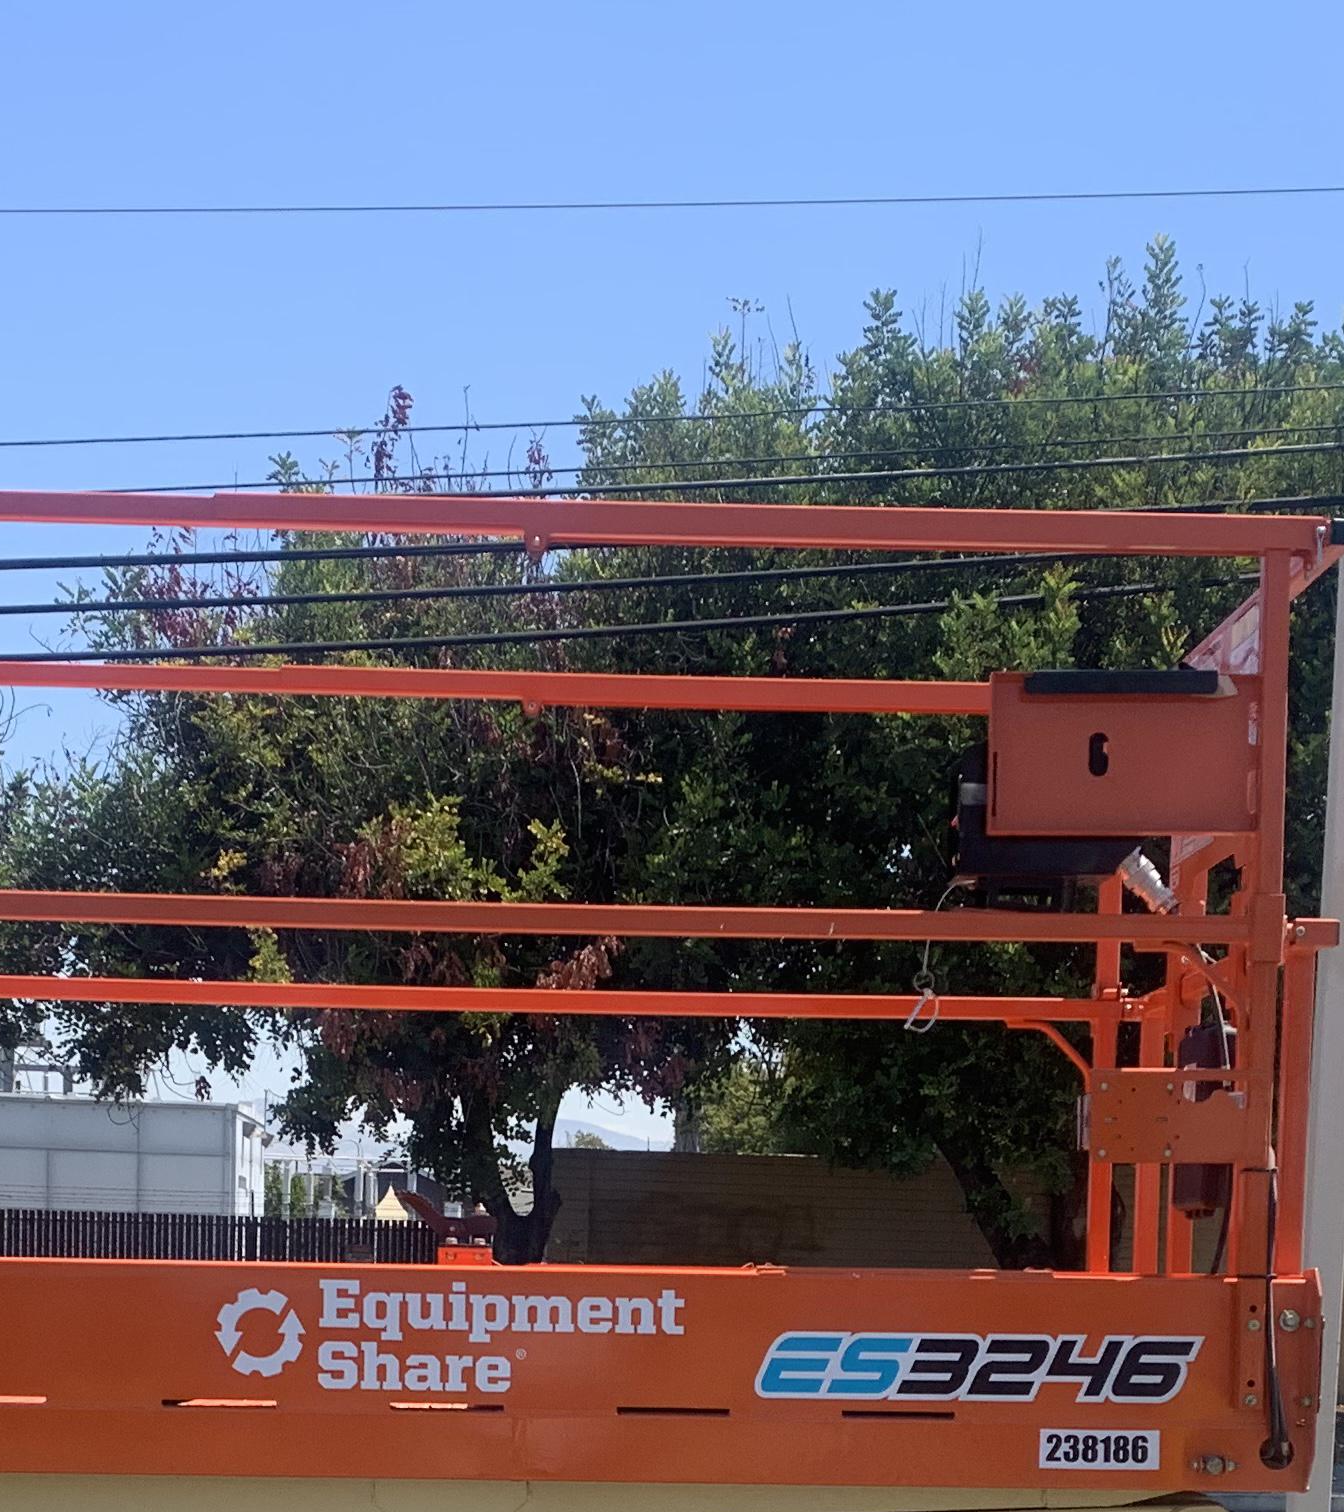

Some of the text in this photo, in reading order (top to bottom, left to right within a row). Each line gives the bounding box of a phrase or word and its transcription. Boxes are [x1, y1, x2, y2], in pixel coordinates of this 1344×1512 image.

[318, 1279, 686, 1343] Equipment
[317, 1341, 512, 1393] Share
[755, 1331, 1204, 1404] ES3246
[1045, 1433, 1149, 1465] 238186
